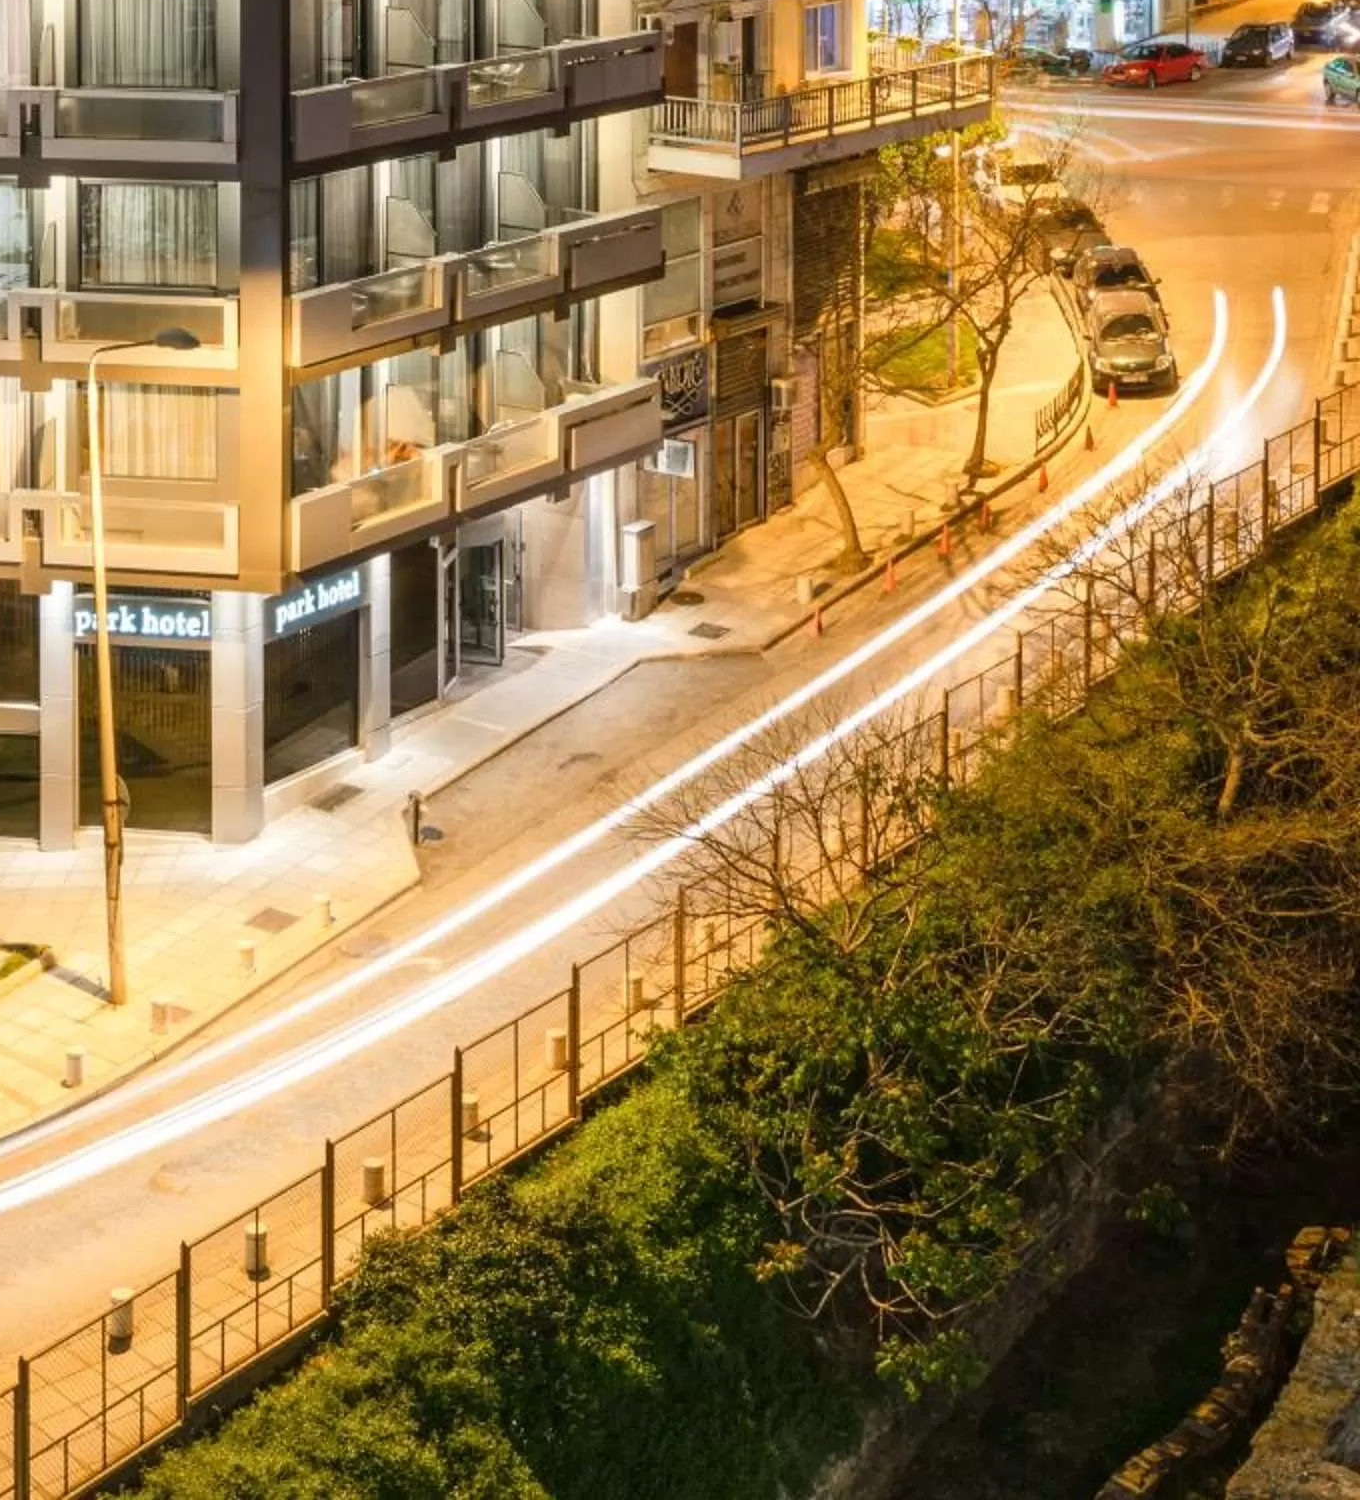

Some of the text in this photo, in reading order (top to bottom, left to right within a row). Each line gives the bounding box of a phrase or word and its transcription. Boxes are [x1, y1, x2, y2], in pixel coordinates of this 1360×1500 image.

[141, 606, 210, 637] hotel
[275, 570, 360, 633] park hotel
